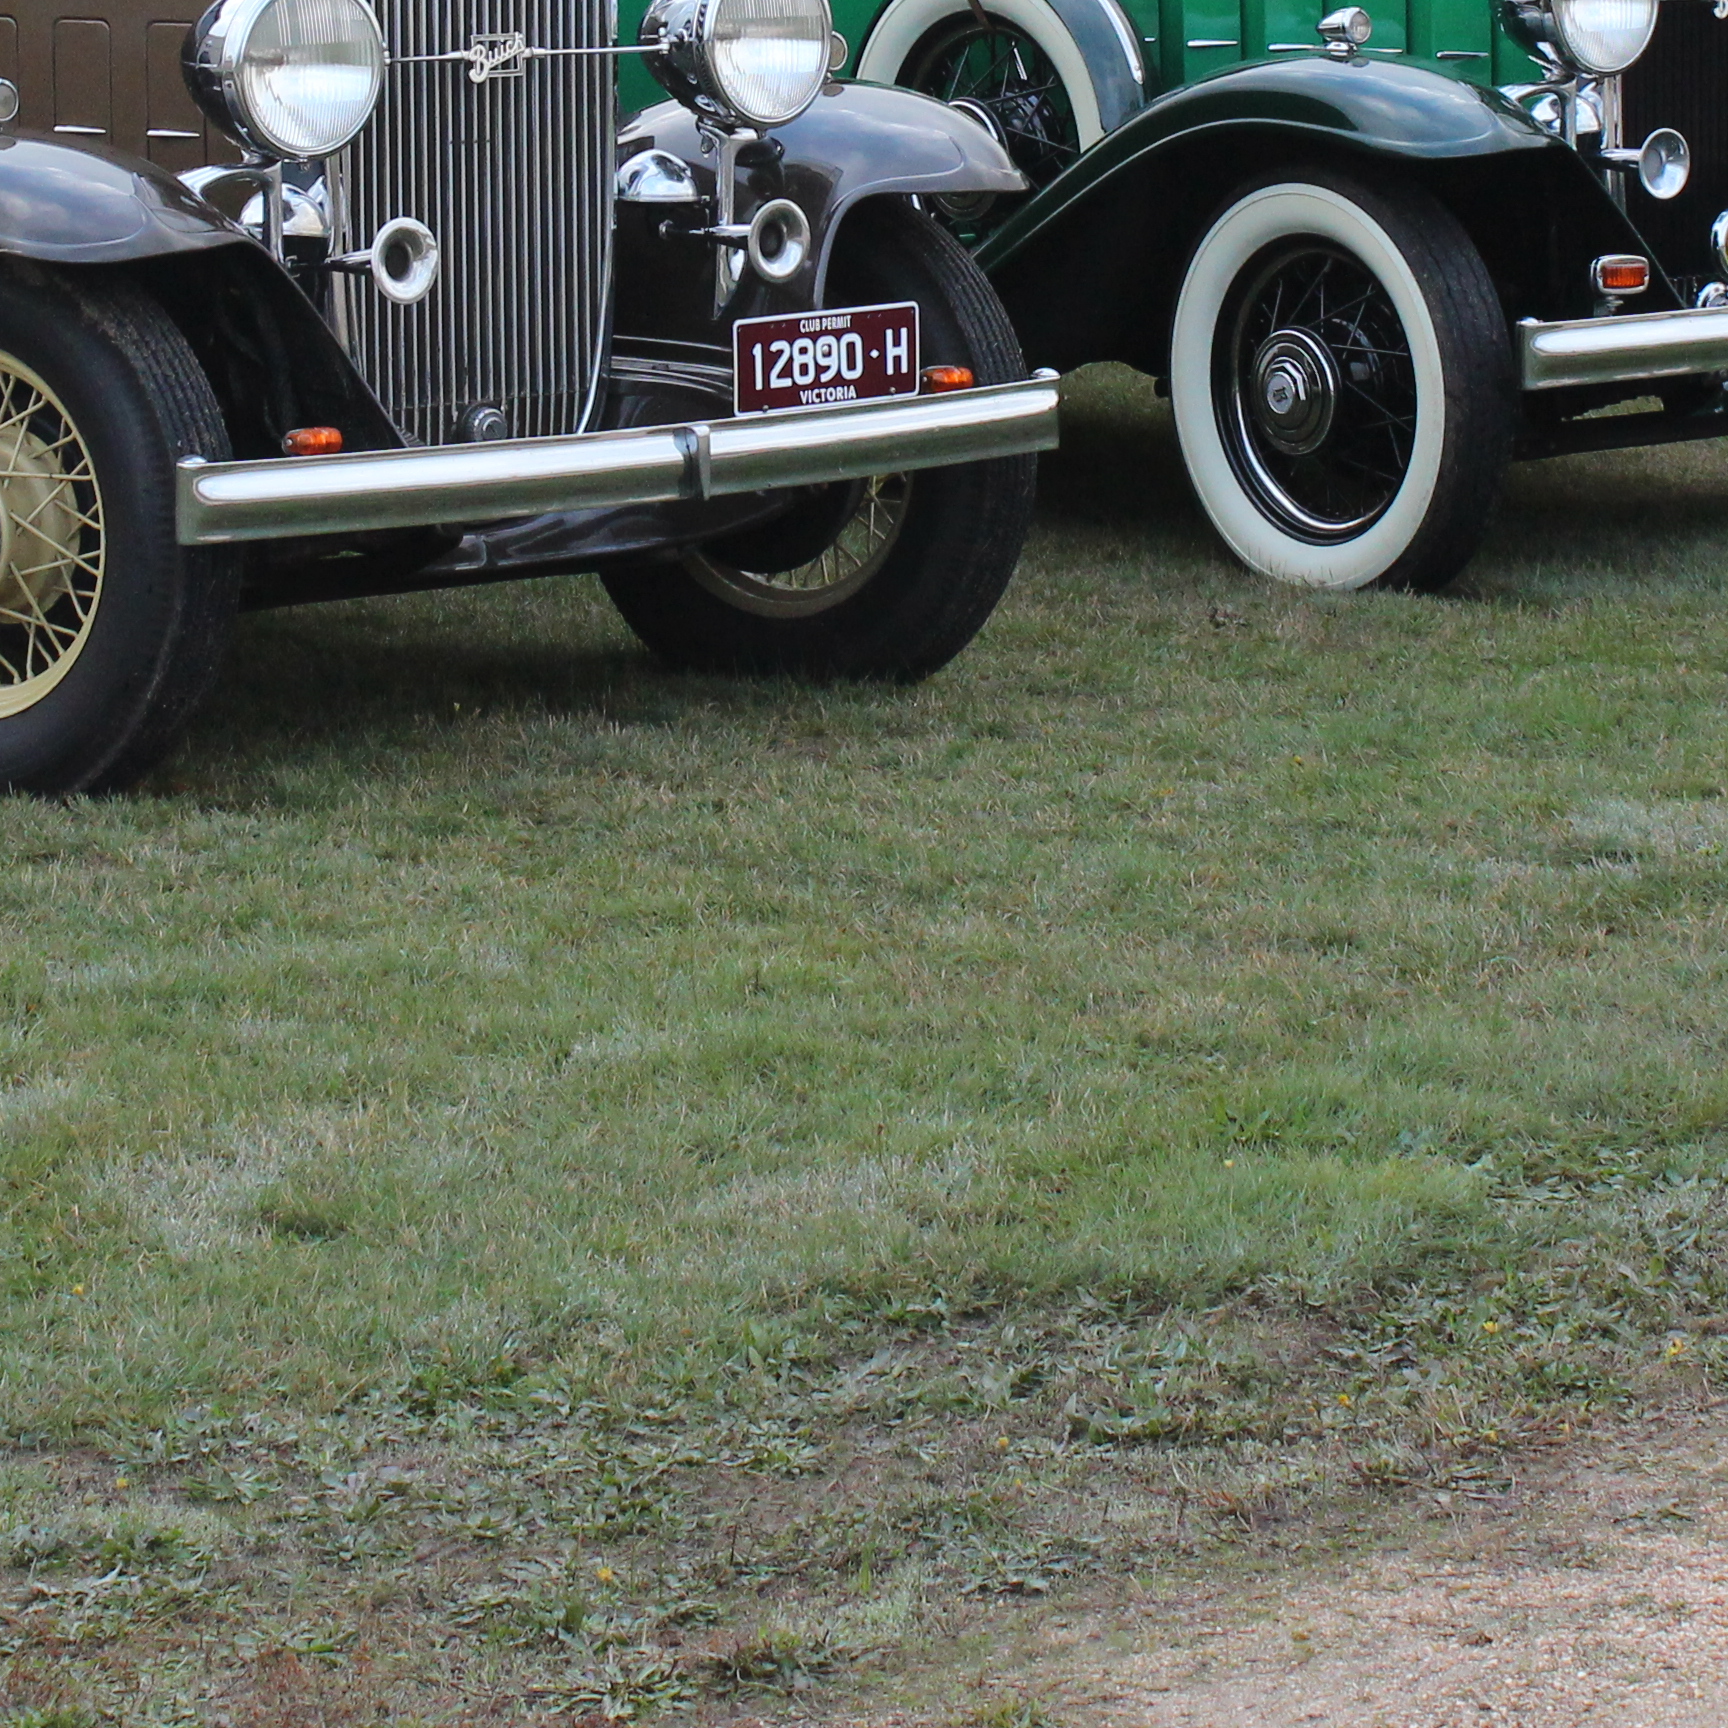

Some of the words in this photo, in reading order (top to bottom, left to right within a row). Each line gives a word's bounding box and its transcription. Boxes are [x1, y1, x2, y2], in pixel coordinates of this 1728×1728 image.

[468, 31, 525, 83] Buick
[799, 319, 821, 334] CLUB
[821, 315, 852, 330] PERMIT
[799, 384, 857, 405] VICTORIA
